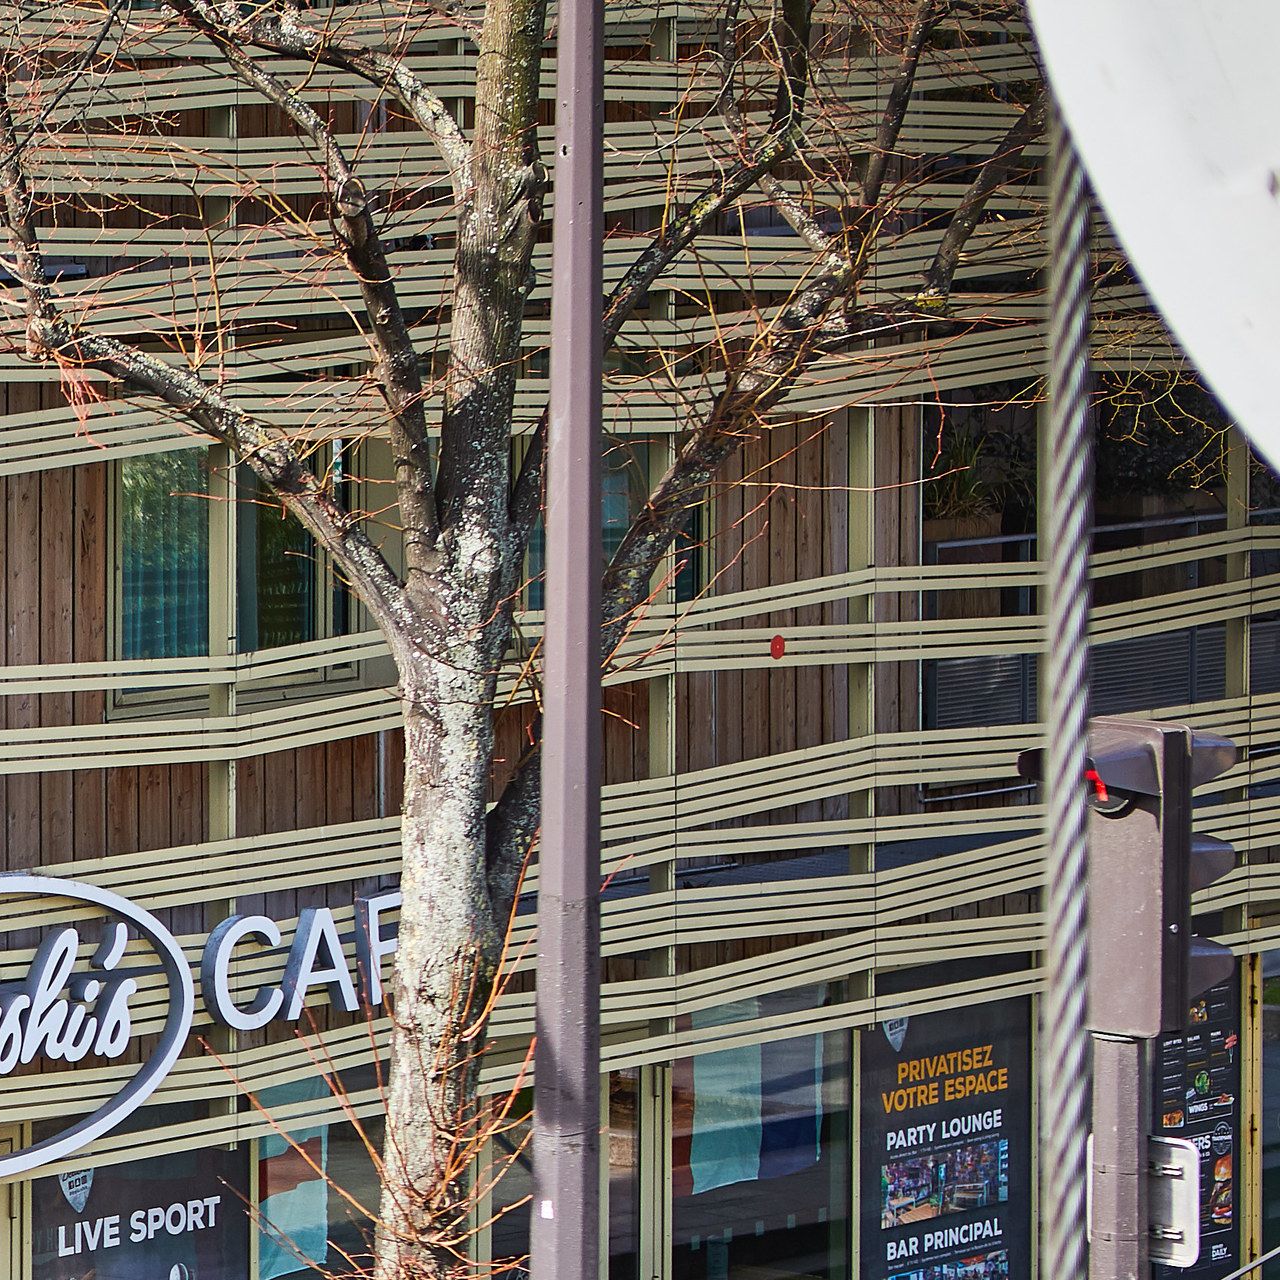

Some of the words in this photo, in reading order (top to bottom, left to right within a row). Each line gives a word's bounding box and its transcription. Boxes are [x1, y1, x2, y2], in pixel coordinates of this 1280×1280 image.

[201, 890, 401, 1030] CAF
[897, 1044, 993, 1084] PRIVATISEZ
[881, 1082, 939, 1113] VOTRE
[944, 1068, 1008, 1101] ESPACE
[886, 1122, 936, 1151] PARTY
[942, 1108, 1002, 1139] LOUNGE
[58, 1214, 120, 1257] LIVE
[129, 1195, 221, 1243] SPORT
[886, 1236, 919, 1261] BAR
[924, 1217, 1003, 1253] PRINCIPAL
